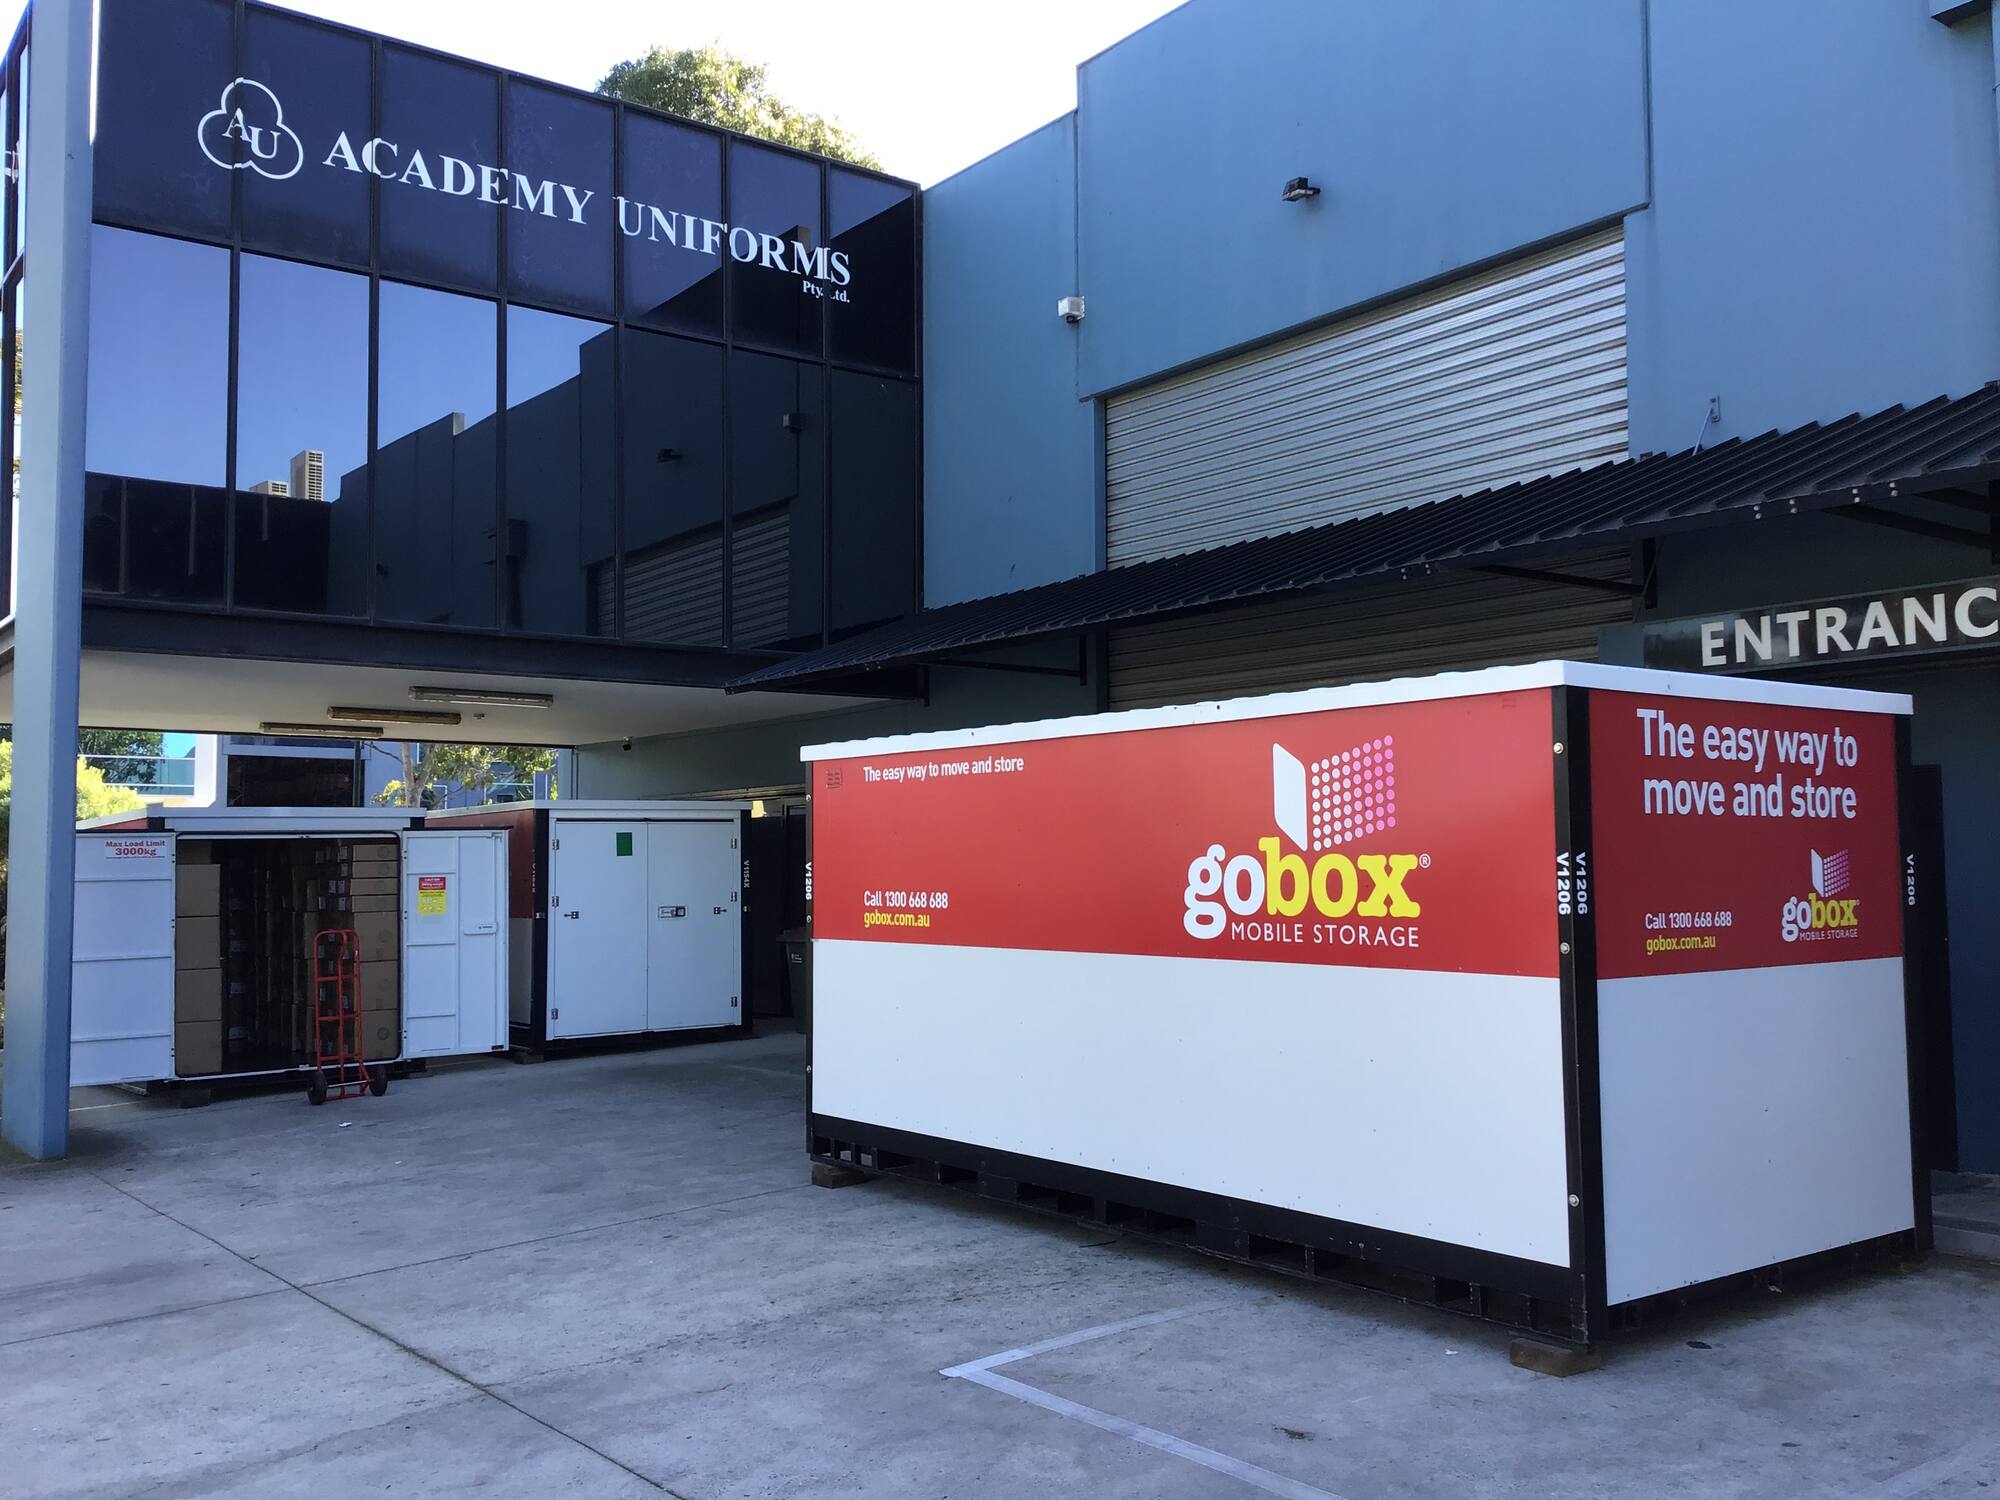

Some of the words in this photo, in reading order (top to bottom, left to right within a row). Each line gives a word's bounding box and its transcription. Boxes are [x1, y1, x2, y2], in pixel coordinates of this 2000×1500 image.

[322, 131, 595, 225] ACADEMY
[612, 195, 851, 286] UNIFORMS
[830, 288, 850, 303] td.
[1700, 587, 1998, 668] ENTRANC
[1636, 708, 1695, 758] The
[1702, 725, 1769, 773] easy
[1774, 730, 1828, 776] way
[1833, 727, 1858, 768] to
[863, 766, 881, 782] The
[882, 766, 904, 783] easy
[906, 764, 928, 781] way
[928, 761, 939, 777] to
[941, 761, 969, 776] move
[972, 756, 992, 774] and
[994, 756, 1024, 772] store
[1643, 778, 1726, 816] move
[1732, 773, 1783, 817] and
[1790, 778, 1857, 819] store
[105, 840, 123, 848] Max
[115, 847, 157, 856] 3000kg
[1556, 851, 1571, 915] V1206
[1575, 851, 1588, 915] V1206
[1906, 853, 1916, 906] V1206
[863, 890, 882, 907] Call
[885, 890, 907, 908] 1300
[908, 891, 927, 908] 668
[929, 892, 949, 909] 688
[863, 909, 930, 928] gobox.com.au
[1644, 913, 1667, 930] Call
[1668, 912, 1692, 929] 1300
[1693, 911, 1712, 928] 668
[1714, 911, 1732, 927] 688
[1781, 892, 1858, 942] gobox
[1231, 922, 1304, 943] MOBILE
[1312, 924, 1420, 948] STORAGE
[1646, 935, 1716, 956] gobox.com.au
[1800, 930, 1826, 941] MOBILE
[1826, 928, 1858, 939] STORAGE
